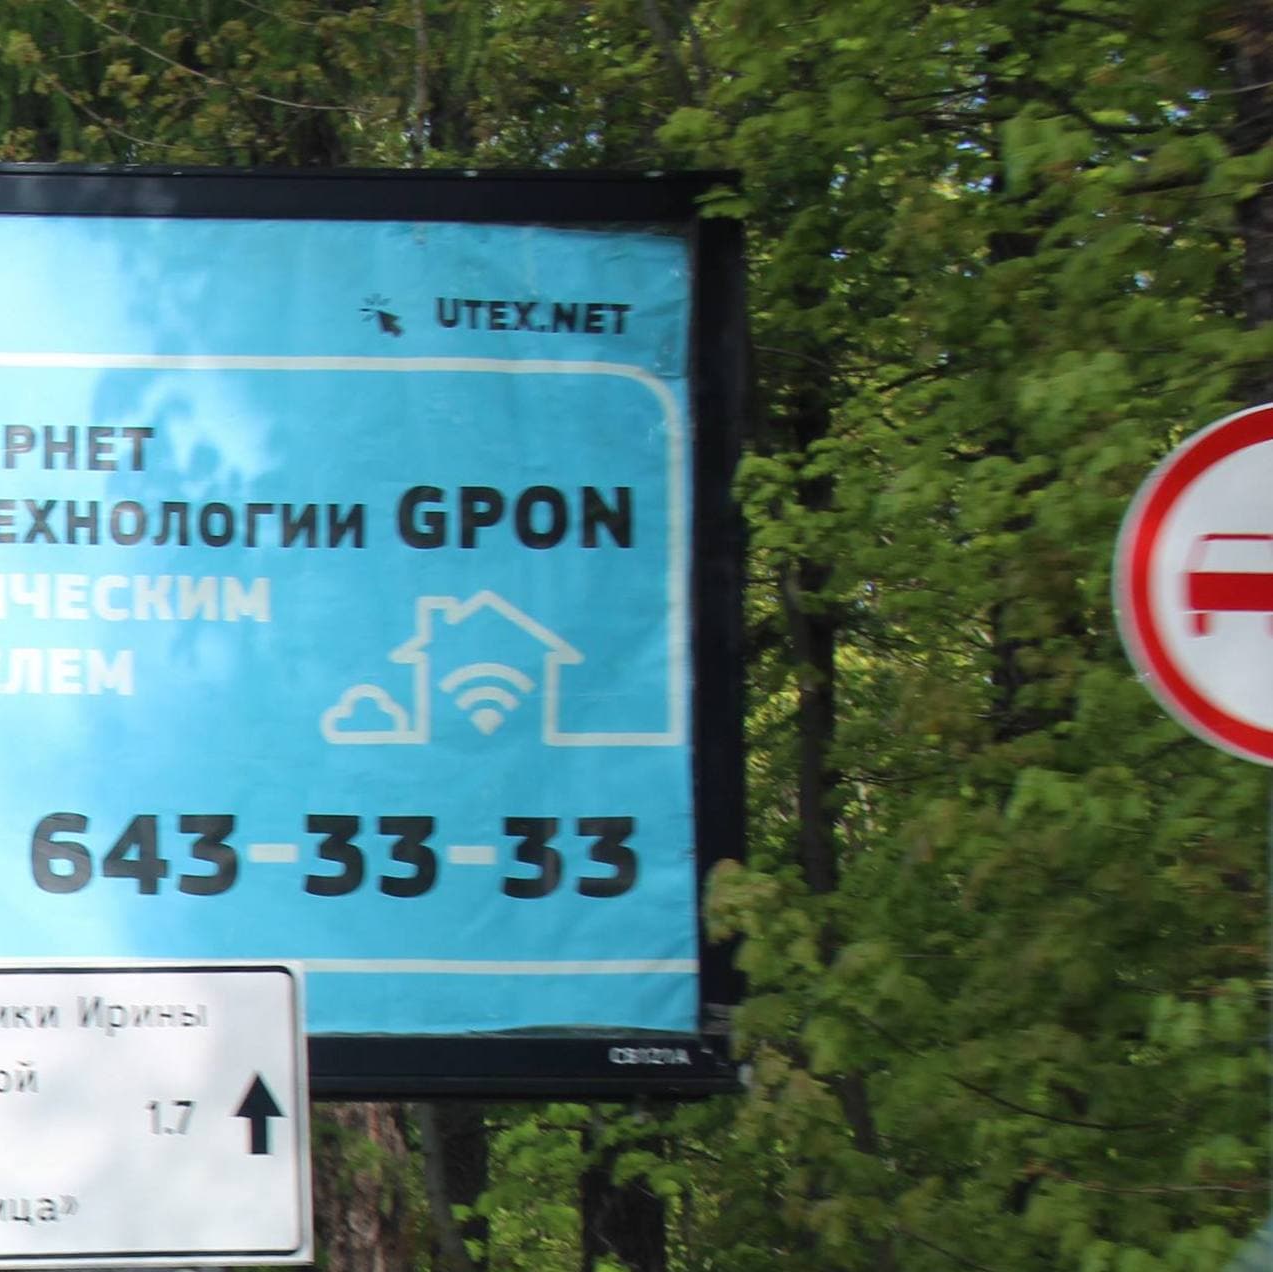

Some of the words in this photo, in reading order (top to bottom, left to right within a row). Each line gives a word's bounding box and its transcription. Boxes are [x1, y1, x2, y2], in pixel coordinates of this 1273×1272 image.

[436, 298, 633, 335] UTEX.NET
[397, 485, 635, 550] GPON
[30, 813, 639, 899] 643-33-33
[76, 996, 208, 1037] Ирины
[145, 1099, 196, 1135] 1.7
